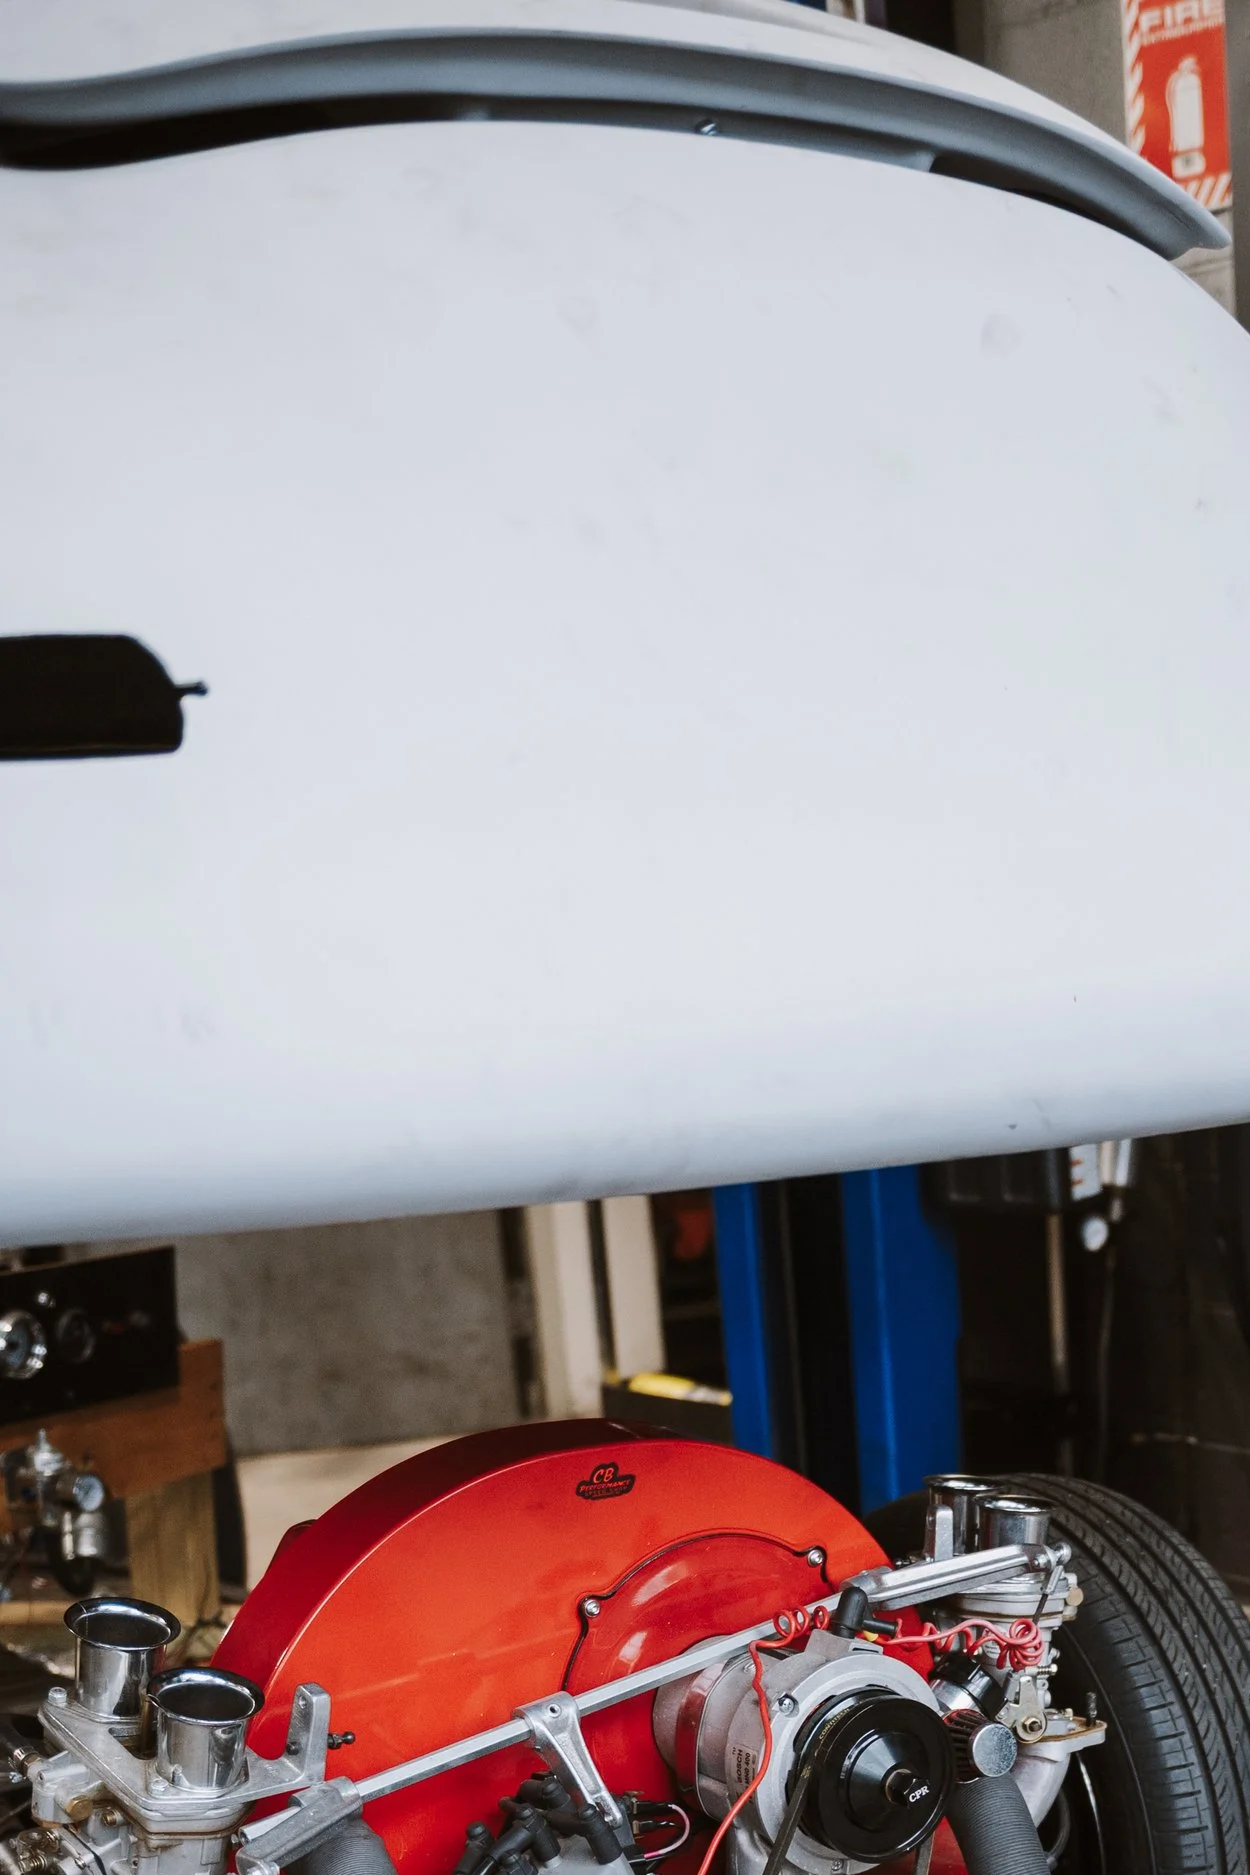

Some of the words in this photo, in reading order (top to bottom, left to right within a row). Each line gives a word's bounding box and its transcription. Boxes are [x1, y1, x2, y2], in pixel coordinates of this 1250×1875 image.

[1138, 0, 1225, 34] FIRE
[593, 1467, 614, 1484] CB
[908, 1785, 930, 1803] CPR
